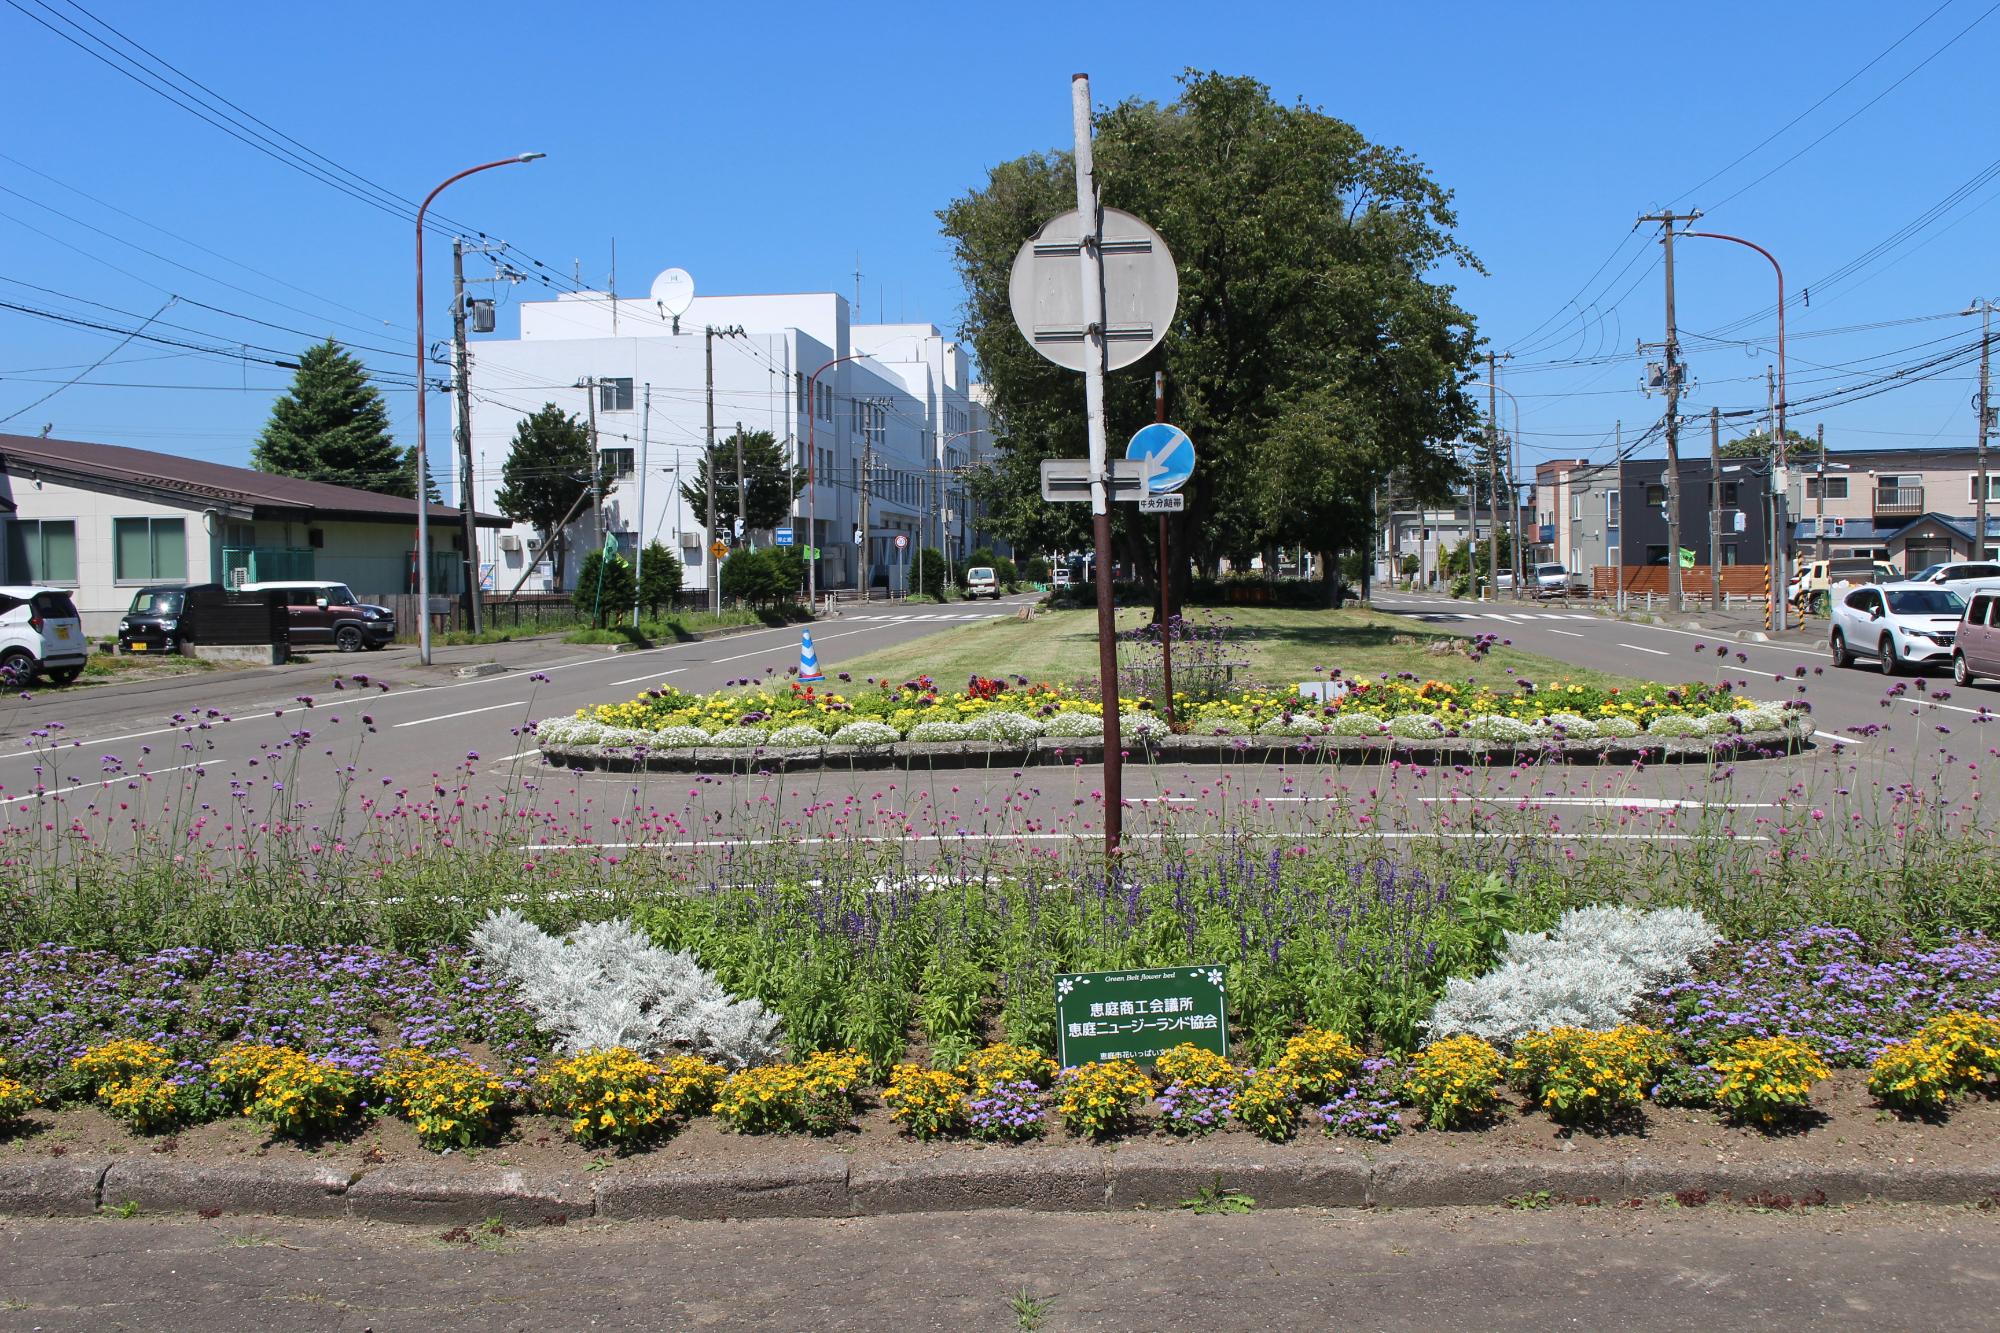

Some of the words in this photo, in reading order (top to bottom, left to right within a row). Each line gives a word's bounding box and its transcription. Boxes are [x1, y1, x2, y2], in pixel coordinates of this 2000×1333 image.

[1140, 973, 1161, 982] flower
[1162, 971, 1176, 979] bed
[1090, 997, 1194, 1018] 恵庭商工会議所
[1067, 1013, 1218, 1038] 恵庭ニュージーランド協会
